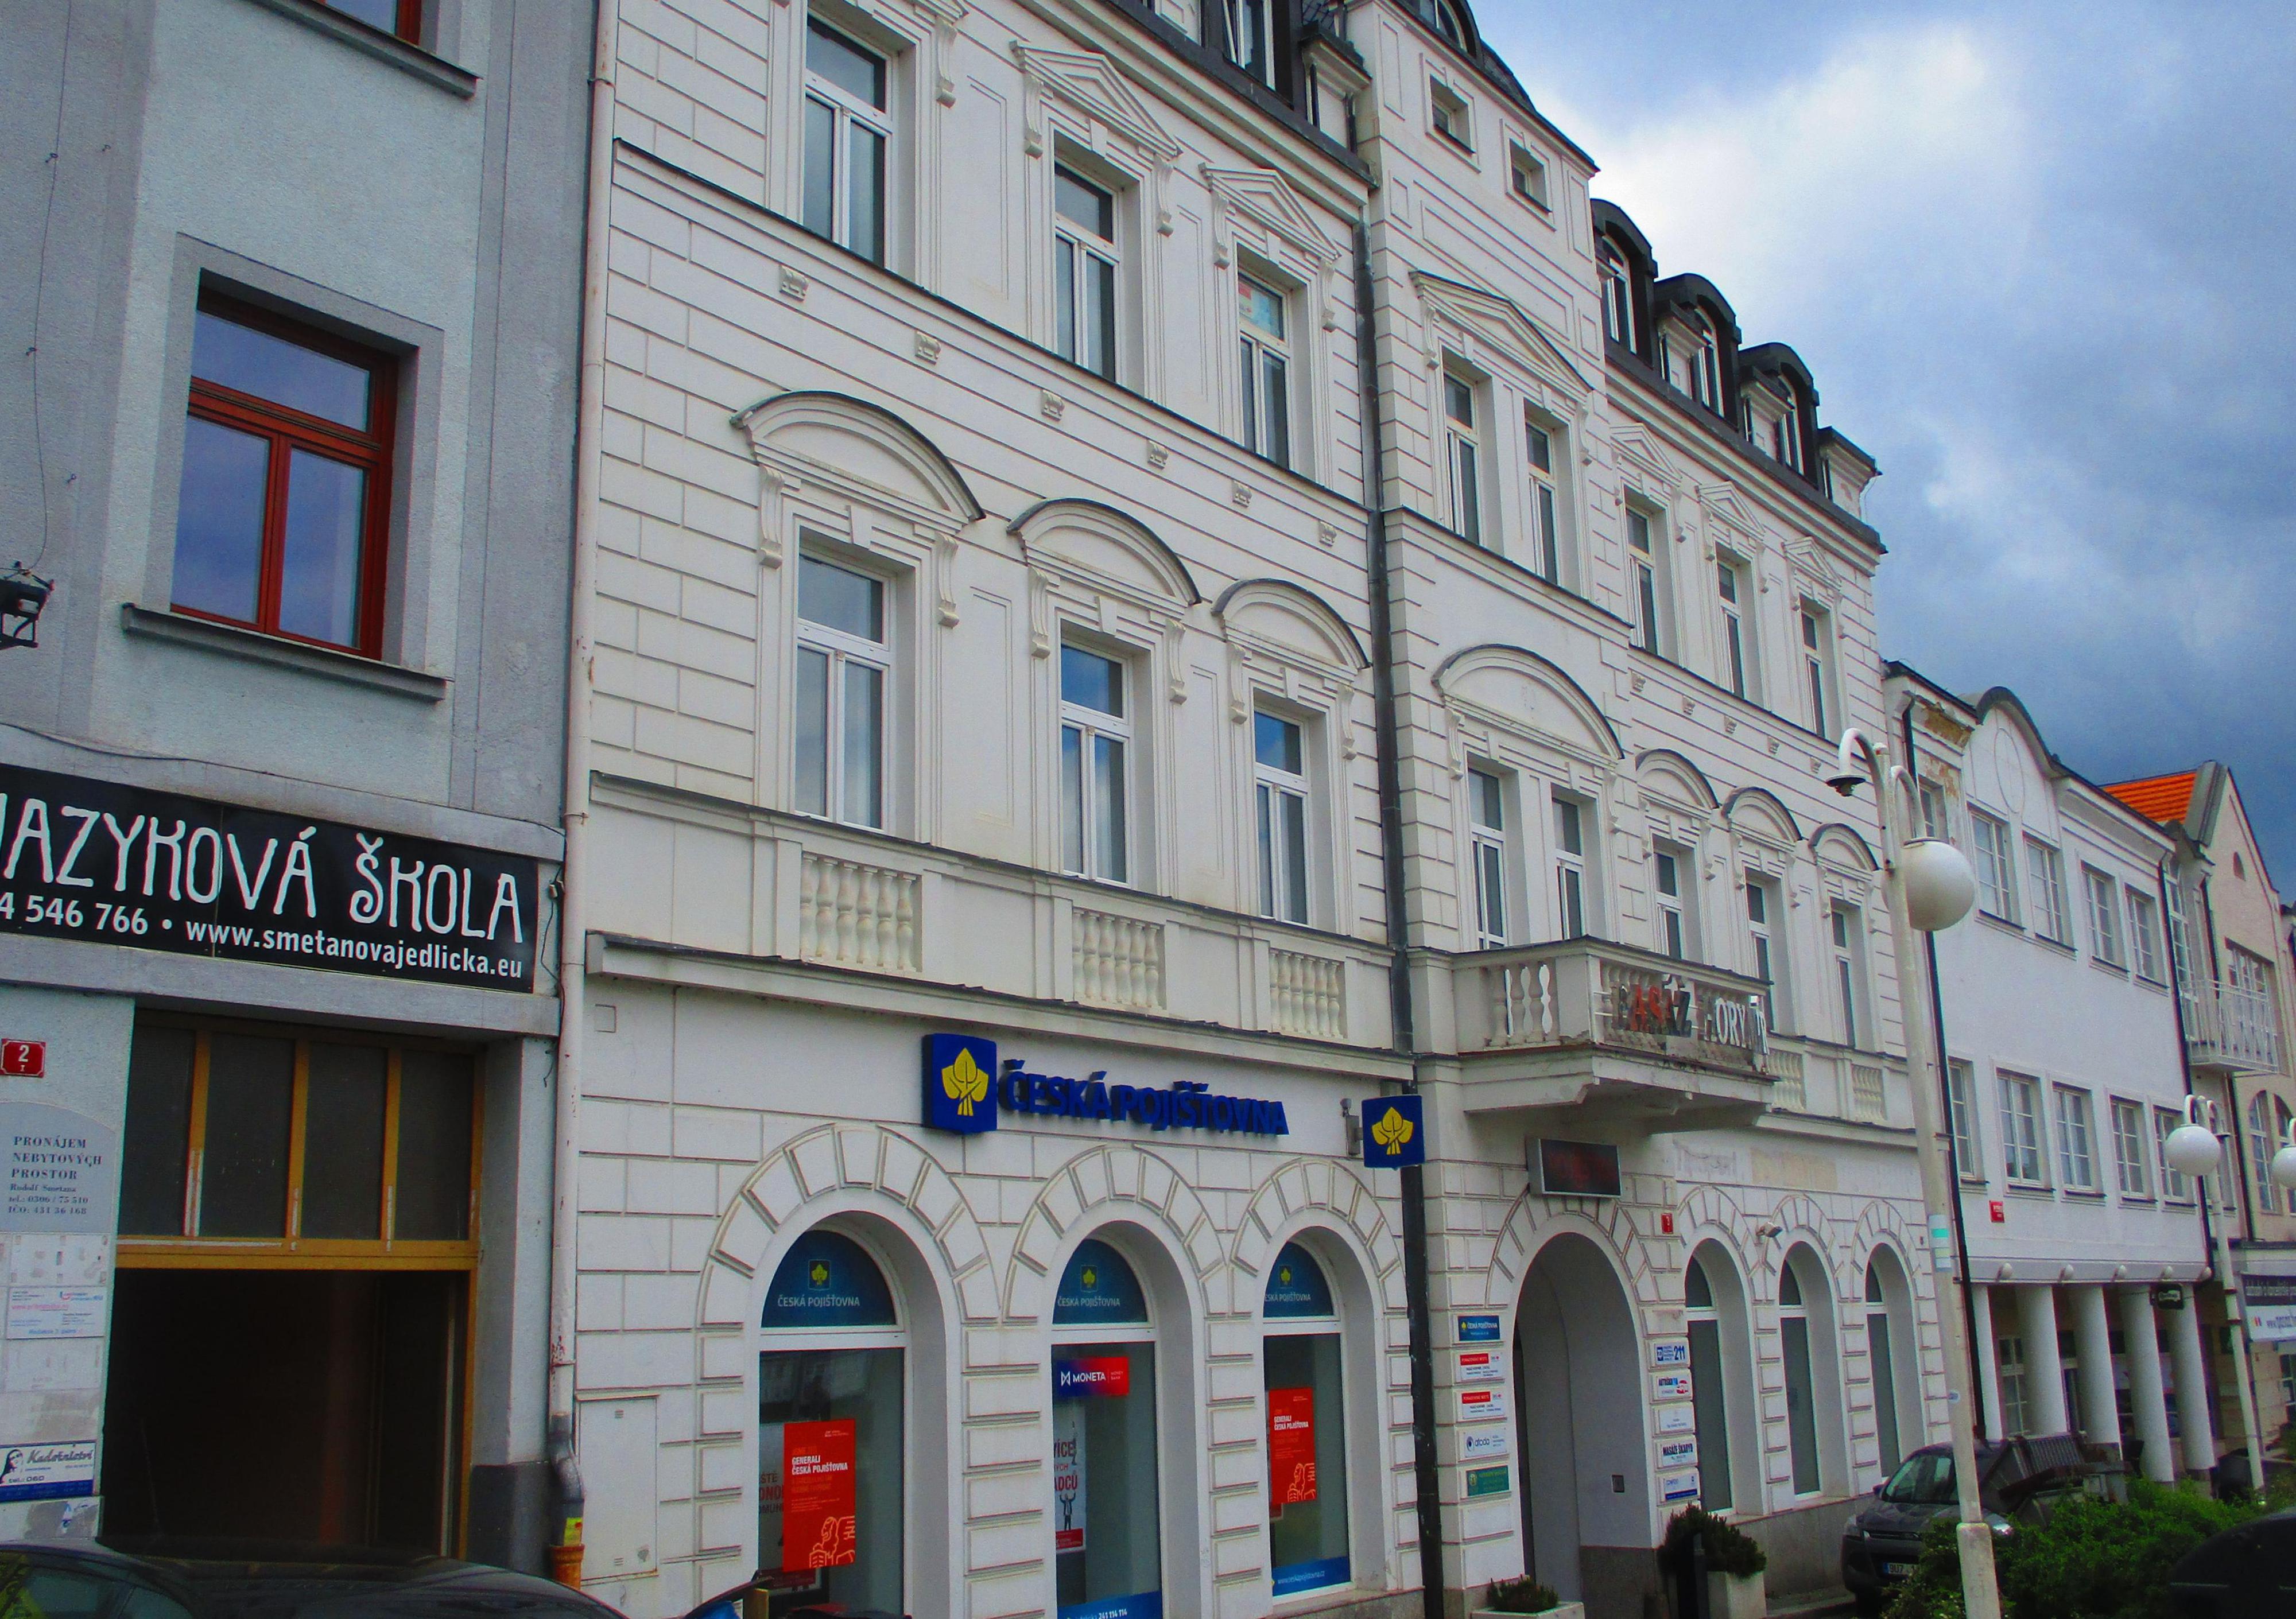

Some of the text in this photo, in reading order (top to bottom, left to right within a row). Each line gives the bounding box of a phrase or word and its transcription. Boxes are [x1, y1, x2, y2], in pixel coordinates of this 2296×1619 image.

[348, 832, 523, 944] ŠKOLA
[25, 895, 83, 928] 546
[95, 903, 148, 935] 766
[185, 921, 523, 979] www.smetanovajedlicka.eu
[18, 1045, 29, 1062] 2
[996, 1059, 1290, 1136] ČESKÁ POJIŠŤOVNA
[14, 1135, 87, 1148] PRONÁJEM
[13, 1152, 102, 1166] NEBYTOVÝCH
[11, 1168, 78, 1179] PROSTOR
[778, 1294, 860, 1308] ČESKÁ POJIŠŤOVNA
[1057, 1295, 1121, 1307] ČESKÁ POJIŠŤOVNA
[1674, 1345, 1686, 1361] 211
[1072, 1372, 1107, 1383] MONETA
[792, 1455, 821, 1466] GENERALI
[792, 1461, 848, 1476] ČESKÁ POJIŠŤOVNA
[1109, 1609, 1119, 1618] 114
[1119, 1608, 1128, 1617] 114
